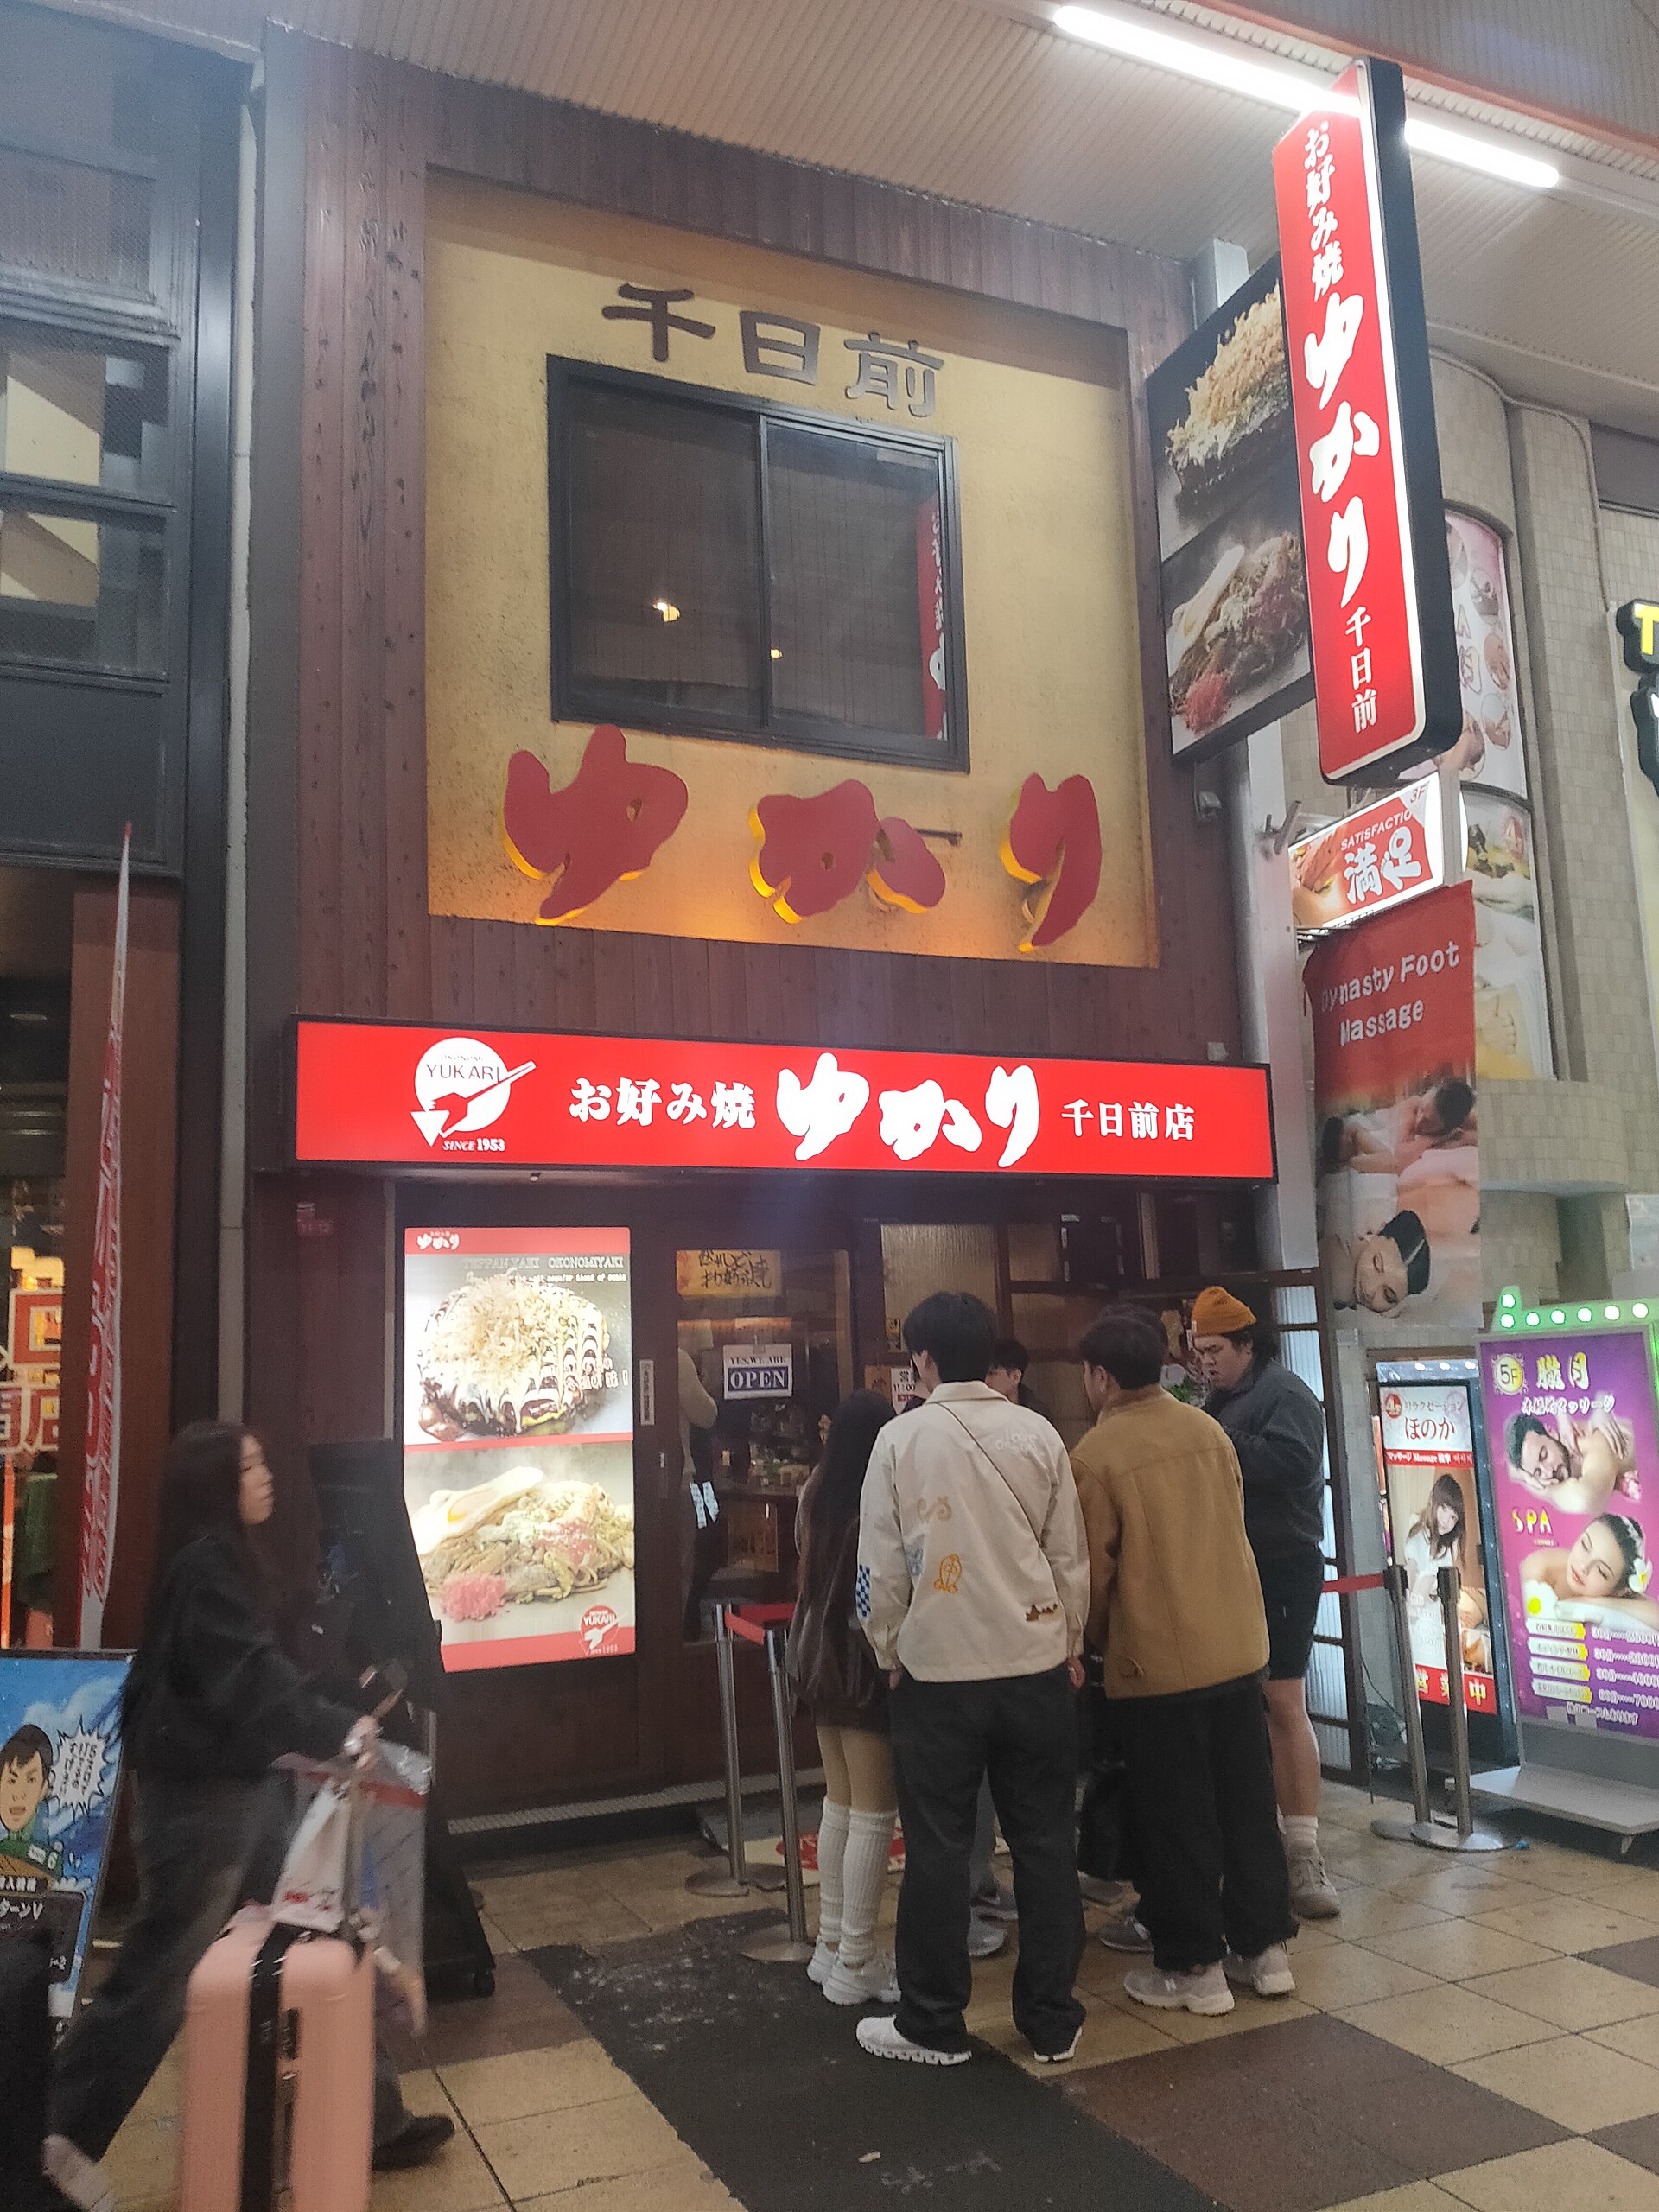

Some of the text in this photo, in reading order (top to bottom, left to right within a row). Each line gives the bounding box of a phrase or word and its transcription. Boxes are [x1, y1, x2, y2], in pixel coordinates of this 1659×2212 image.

[601, 283, 944, 417] 千日前
[1304, 120, 1381, 734] お好み焼 ゆかり 千日前
[501, 723, 1103, 952] ゆかり
[1344, 825, 1422, 905] 満足
[1400, 940, 1460, 983] Foot
[425, 1063, 500, 1083] YUKARI
[569, 1052, 1195, 1168] お好み焼 ゆかり 千日前店
[442, 1137, 505, 1152] SINCE 1953
[416, 1232, 460, 1251] ゆかり
[730, 1370, 785, 1389] OPEN
[1499, 1364, 1519, 1384] 5F
[1404, 1416, 1455, 1441] ほのか
[1511, 1506, 1554, 1535] SPA
